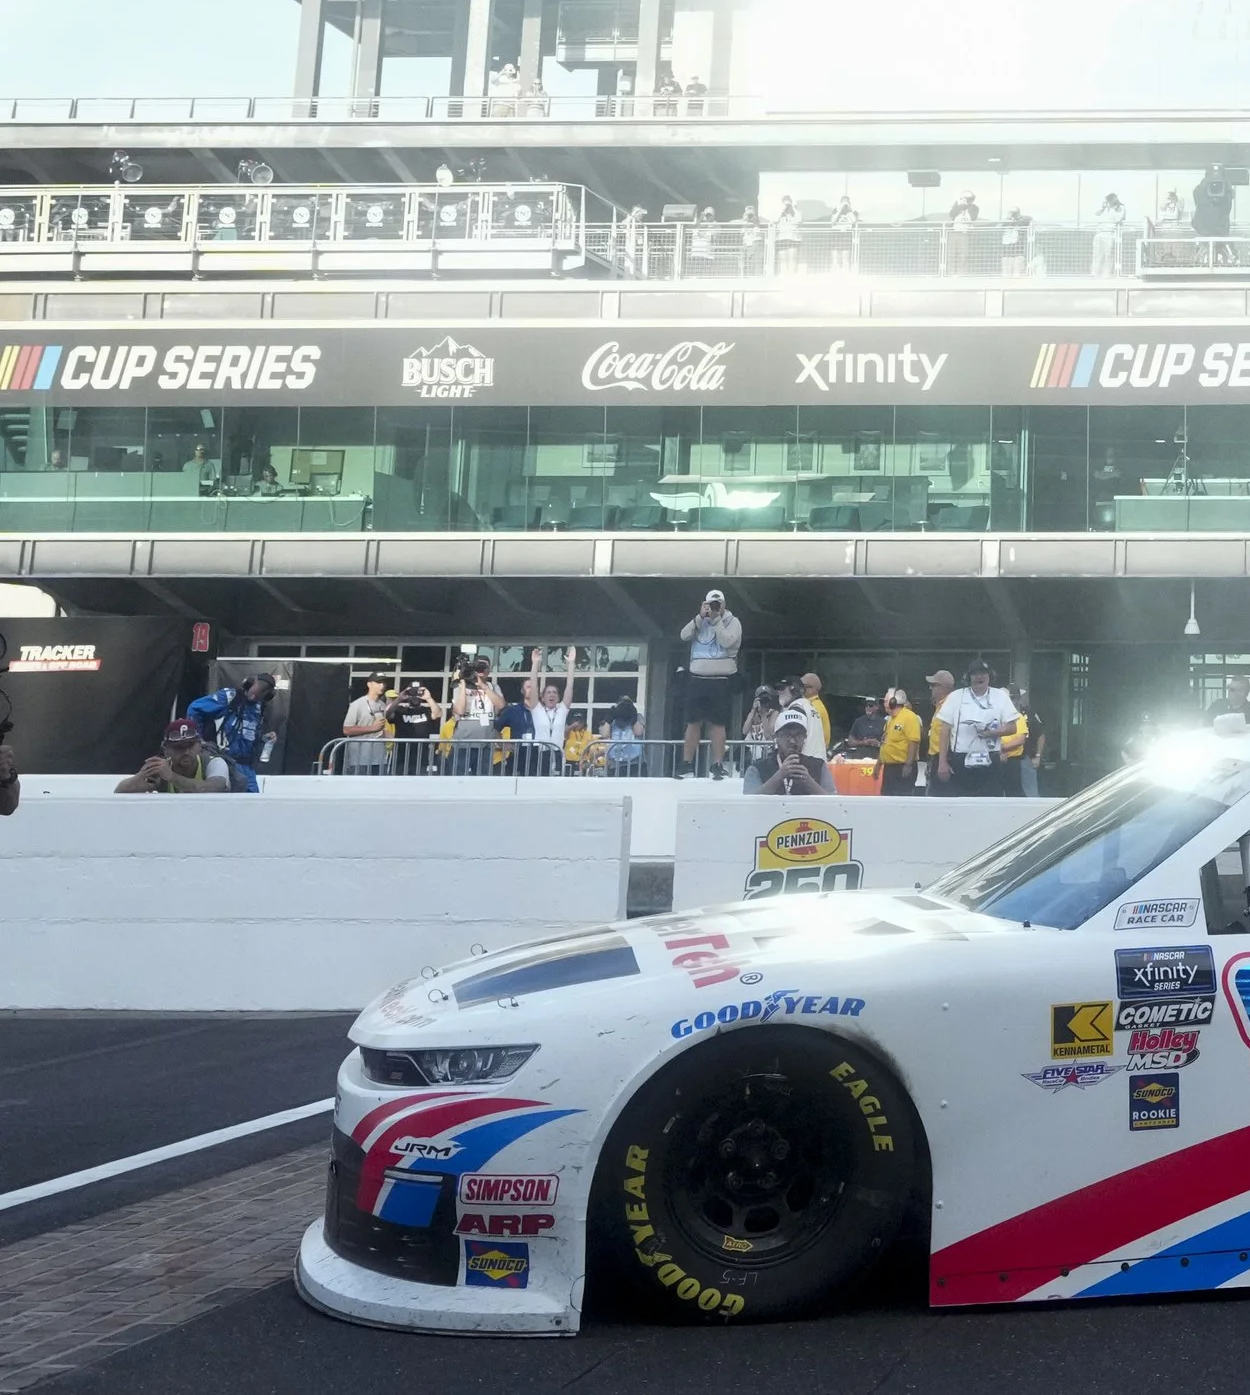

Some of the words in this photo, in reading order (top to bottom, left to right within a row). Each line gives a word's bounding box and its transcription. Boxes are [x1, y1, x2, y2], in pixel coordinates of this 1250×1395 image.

[60, 345, 158, 389] CUP
[158, 345, 321, 389] SERIES
[401, 357, 494, 387] BUSCH
[581, 340, 736, 390] Coca-Cola
[795, 340, 948, 390] xfinity
[1099, 342, 1197, 388] CUP
[421, 386, 473, 398] LIGHT
[20, 645, 96, 661] TRACKER
[860, 767, 874, 776] 39
[777, 830, 829, 849] PENNZOIL
[1143, 902, 1187, 913] NASCAR
[1127, 914, 1157, 925] RACE
[1161, 914, 1185, 923] CAR
[1153, 951, 1185, 961] NASCAR
[1134, 962, 1198, 987] xfinity
[1154, 981, 1180, 991] SERIES
[1119, 1001, 1212, 1025] COMETIC
[1130, 1028, 1200, 1054] Holley
[1053, 1043, 1111, 1057] KENNAMETAL
[1126, 1051, 1188, 1071] MSD
[1043, 1067, 1072, 1079] FIVE
[1134, 1087, 1174, 1099] SUNOCO
[829, 1061, 895, 1153] EAGLE
[1132, 1108, 1176, 1120] ROOKIE
[394, 1143, 451, 1159] JRM
[465, 1179, 551, 1202] SIMPSON
[456, 1214, 555, 1235] ARP
[470, 1257, 526, 1272] SUNOCO
